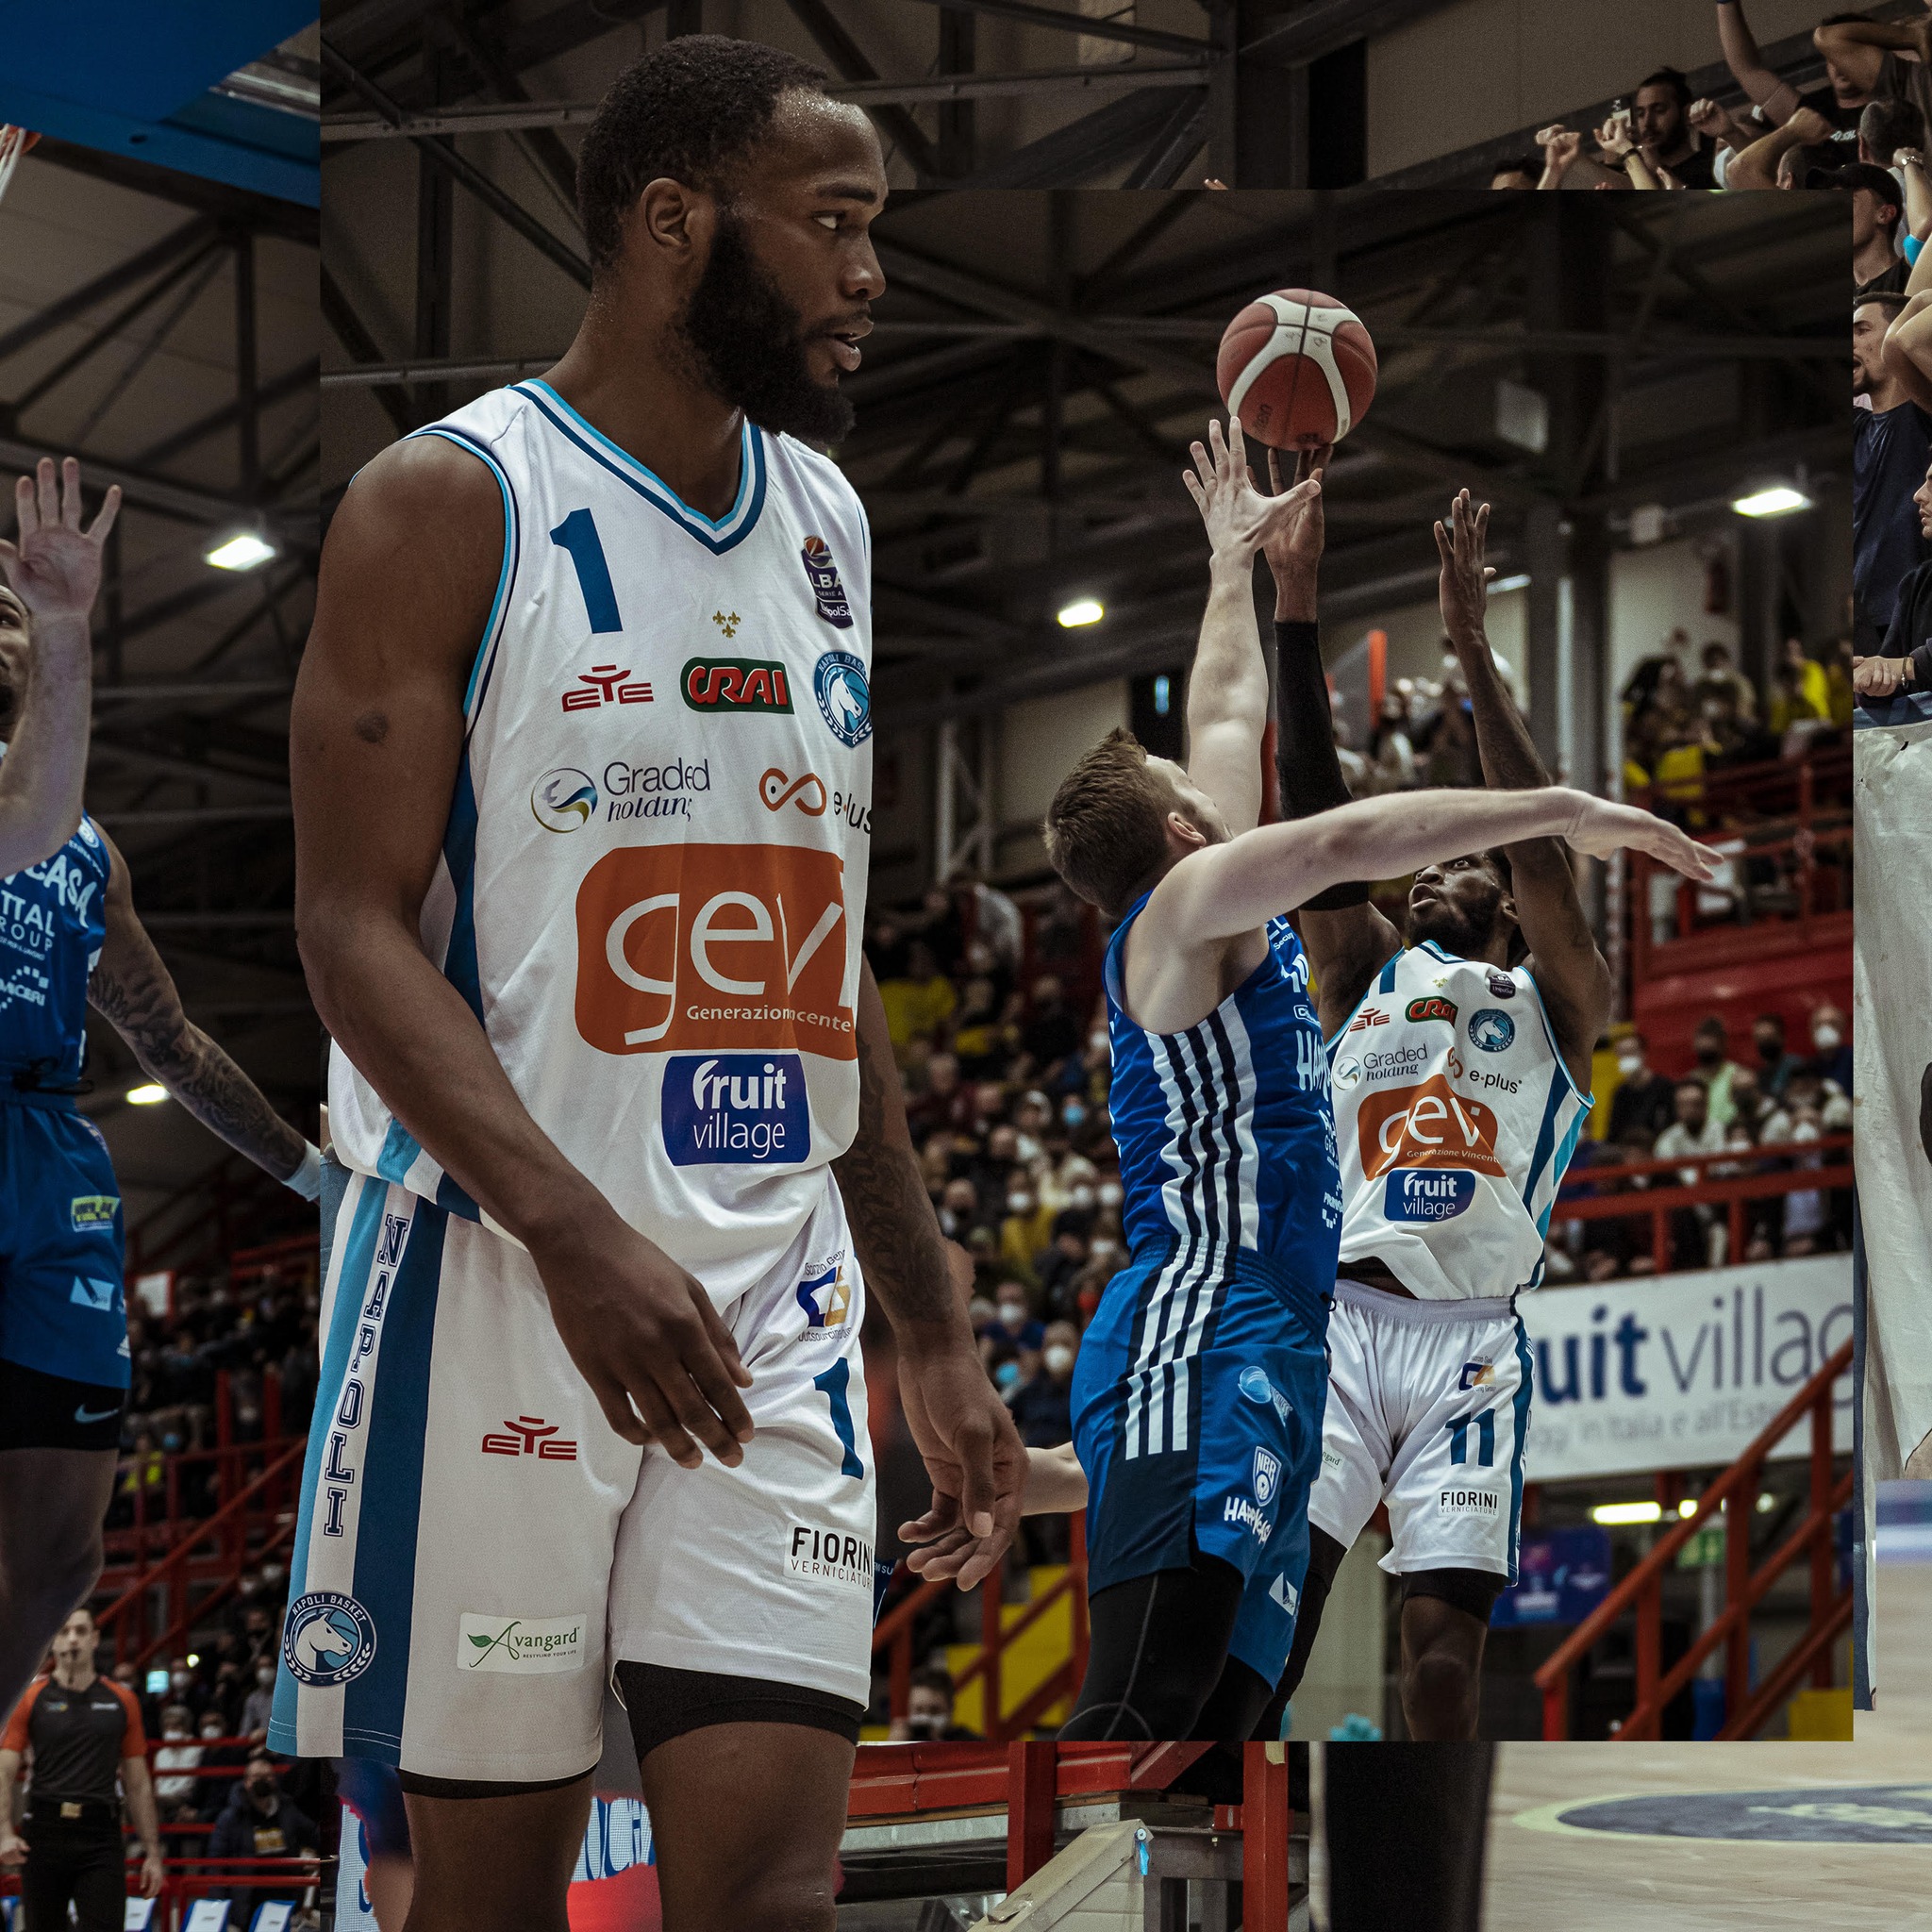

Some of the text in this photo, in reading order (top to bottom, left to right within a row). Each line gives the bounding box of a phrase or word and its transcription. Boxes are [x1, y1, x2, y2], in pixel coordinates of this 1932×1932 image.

[549, 508, 624, 634] 1
[818, 654, 840, 673] NAPOLI
[687, 665, 789, 706] CRAI
[604, 757, 710, 796] Graded
[0, 915, 54, 951] ROUP
[1363, 1042, 1429, 1070] Graded
[692, 1058, 787, 1110] fruit
[692, 1112, 786, 1159] village
[1407, 1149, 1459, 1158] Generazione
[1403, 1172, 1457, 1197] fruit
[1403, 1198, 1456, 1221] village
[324, 1213, 409, 1538] NAPOLI
[1537, 1306, 1648, 1406] uit
[812, 1357, 865, 1480] 1
[1445, 1407, 1496, 1468] 11
[1323, 1451, 1341, 1466] ngard
[1441, 1491, 1498, 1509] FIORINI
[1441, 1507, 1497, 1516] VERNICIATURE
[791, 1526, 874, 1577] FIORINI
[291, 1594, 367, 1623] NAPOLI BASKET
[467, 1621, 578, 1668] Avangard
